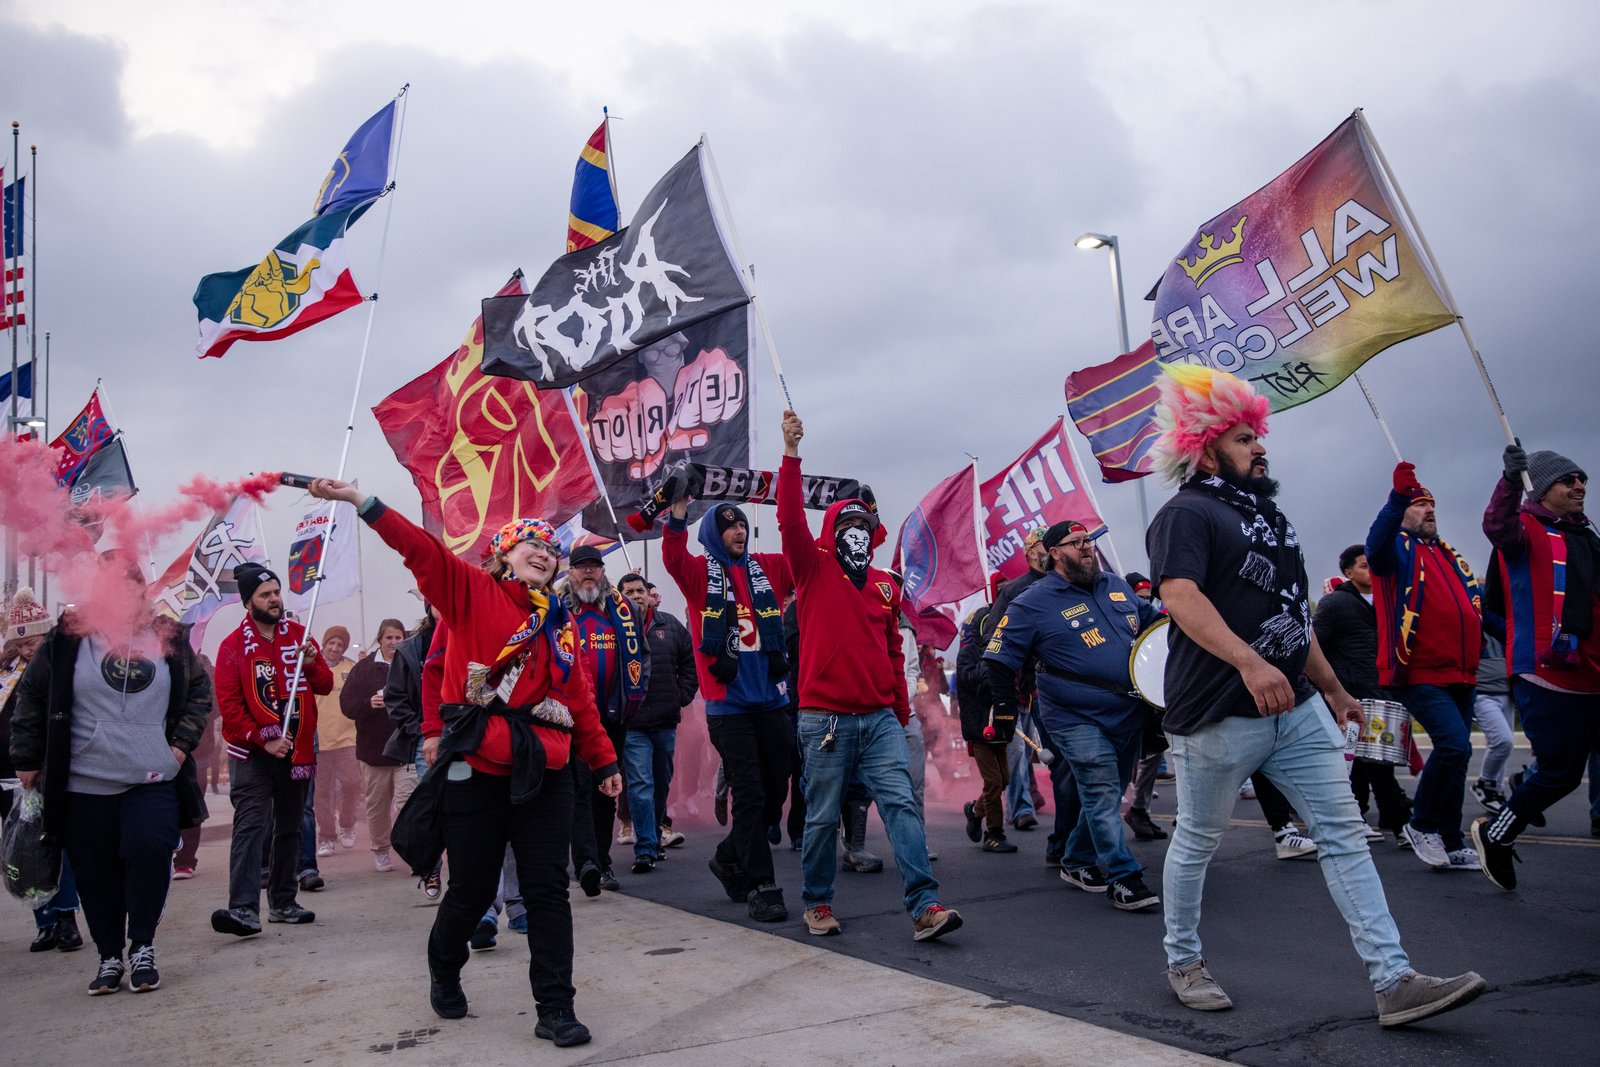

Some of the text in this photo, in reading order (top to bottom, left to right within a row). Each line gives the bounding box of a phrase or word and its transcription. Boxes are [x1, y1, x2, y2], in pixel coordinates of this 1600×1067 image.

[702, 467, 840, 506] BELIVE
[1063, 604, 1088, 618] BRIGADE
[590, 632, 616, 641] Selec
[1081, 627, 1106, 649] FUKC
